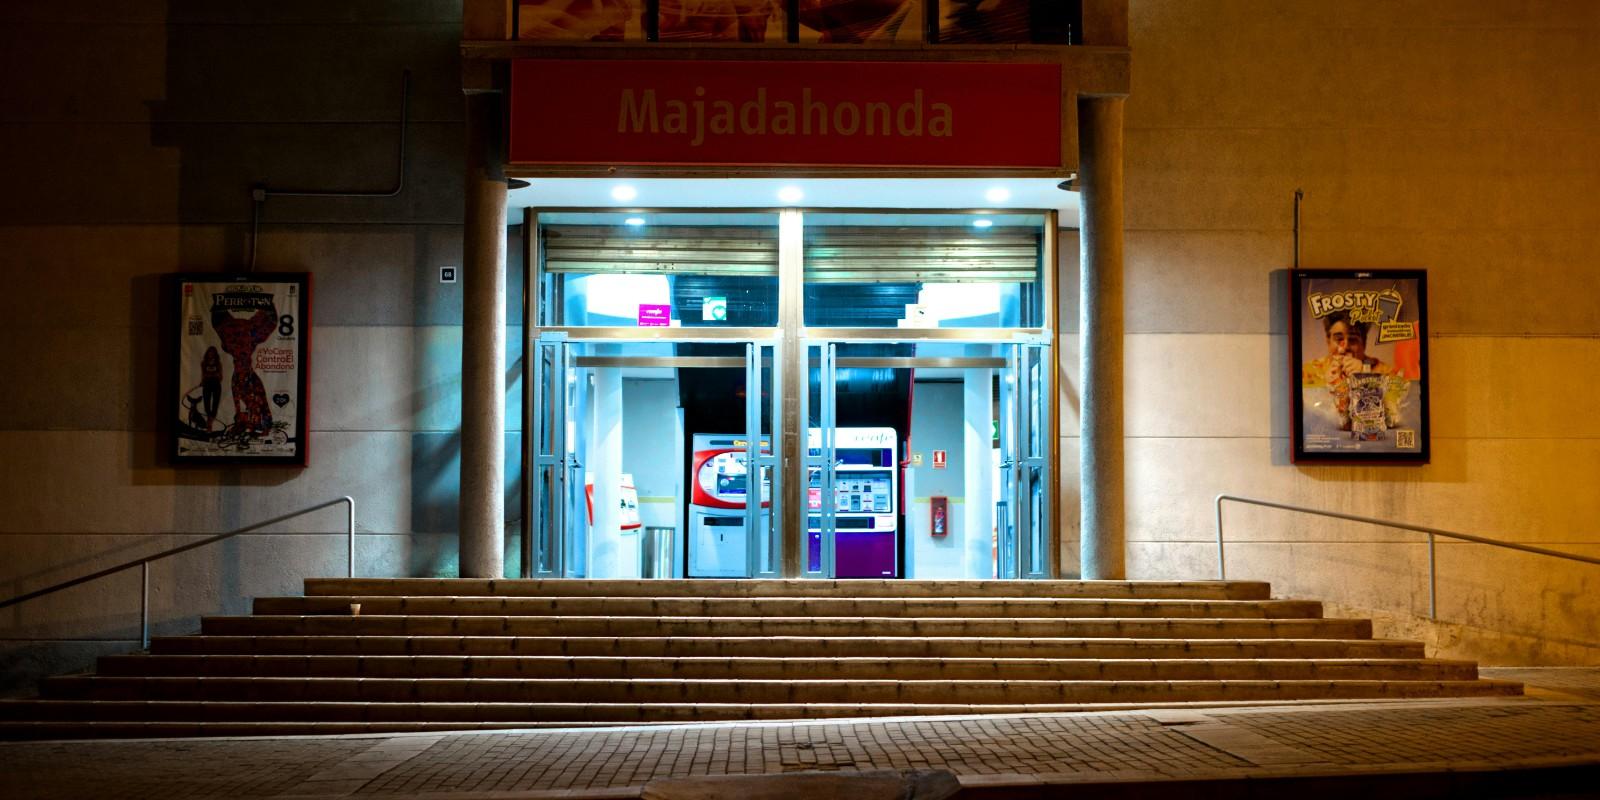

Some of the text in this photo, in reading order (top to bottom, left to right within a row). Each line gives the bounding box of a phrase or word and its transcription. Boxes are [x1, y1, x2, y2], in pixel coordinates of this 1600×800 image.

[617, 87, 955, 147] Majadahonda
[1310, 292, 1377, 315] FROSTY
[278, 314, 294, 336] 8
[255, 362, 295, 370] Abandono
